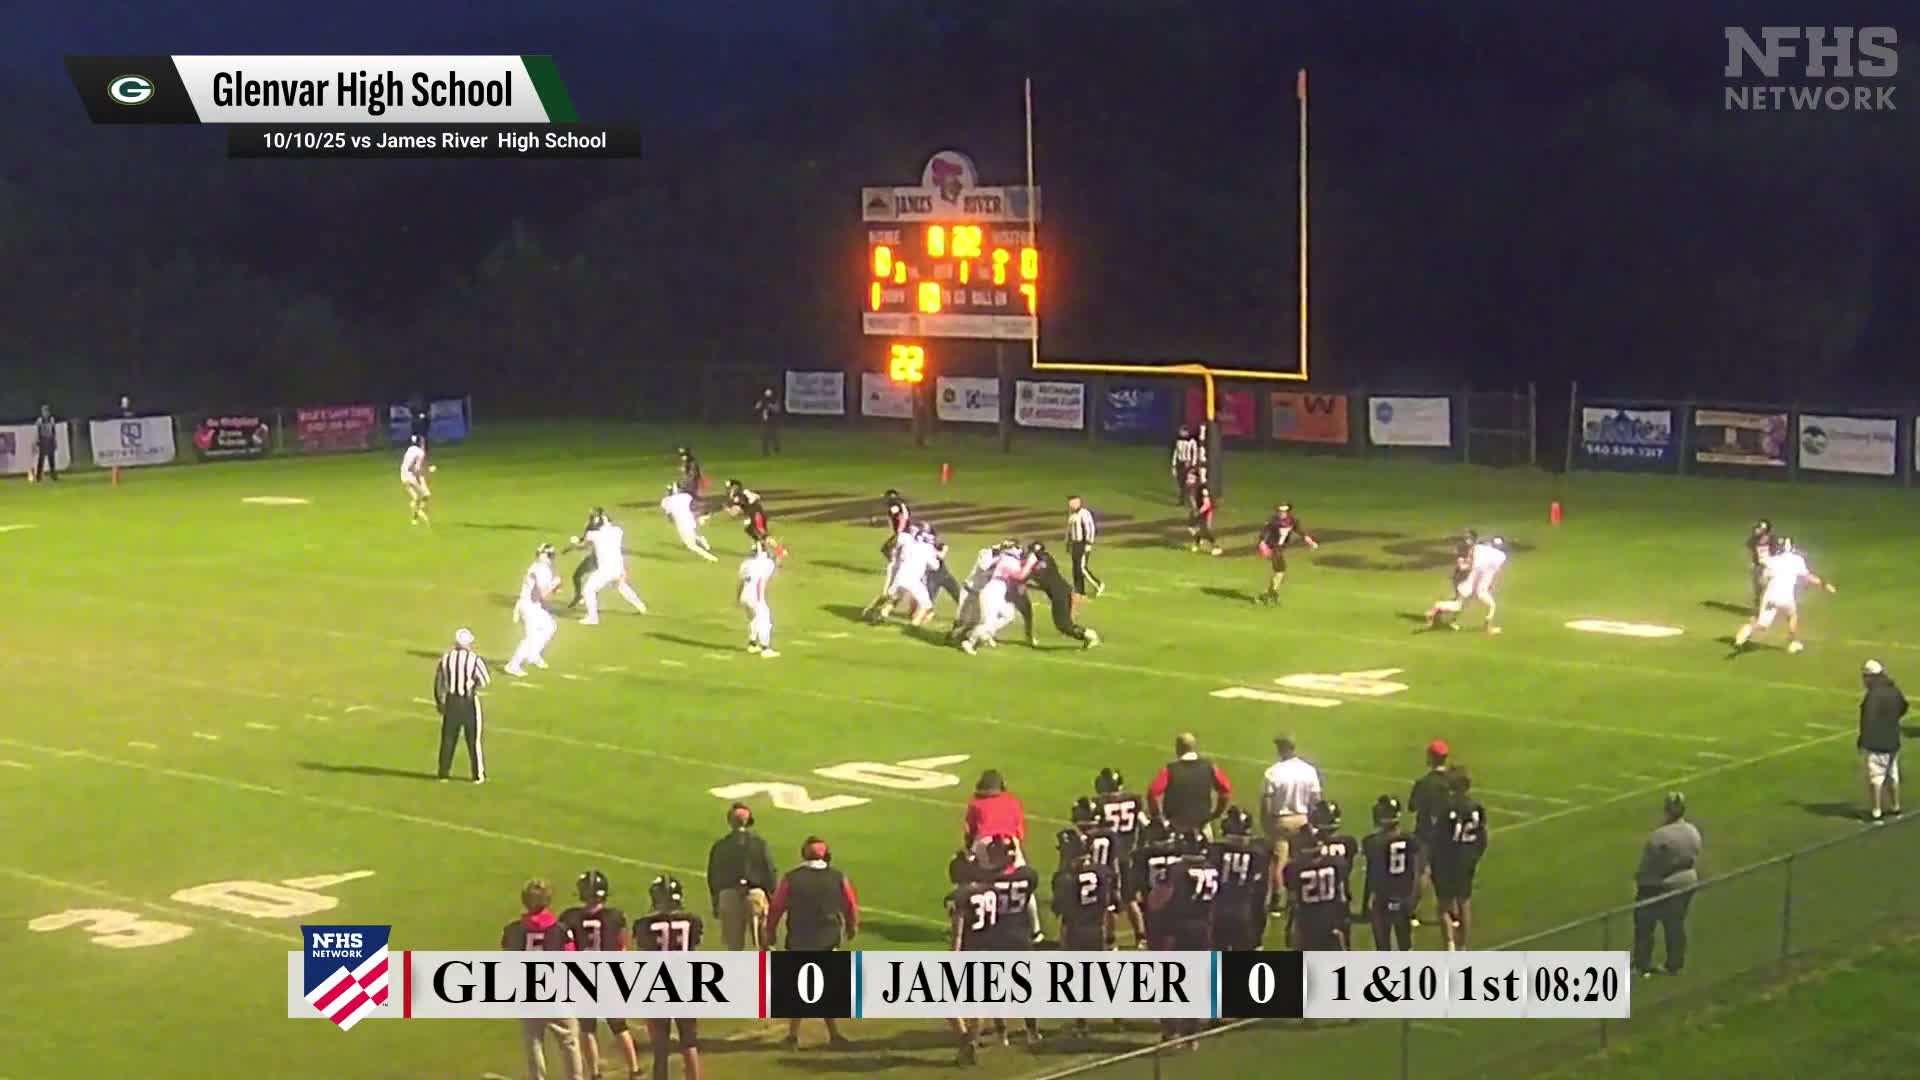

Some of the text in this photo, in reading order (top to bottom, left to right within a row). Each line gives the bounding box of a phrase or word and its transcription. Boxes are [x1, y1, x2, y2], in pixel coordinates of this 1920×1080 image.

[709, 761, 960, 813] 20
[1104, 800, 1136, 832] 55
[1222, 852, 1251, 886] 14
[1389, 840, 1406, 874] 6
[1079, 871, 1098, 905] 2
[1188, 867, 1218, 900] 75
[1300, 866, 1335, 903] 20
[28, 879, 340, 948] 30
[970, 890, 997, 931] 39
